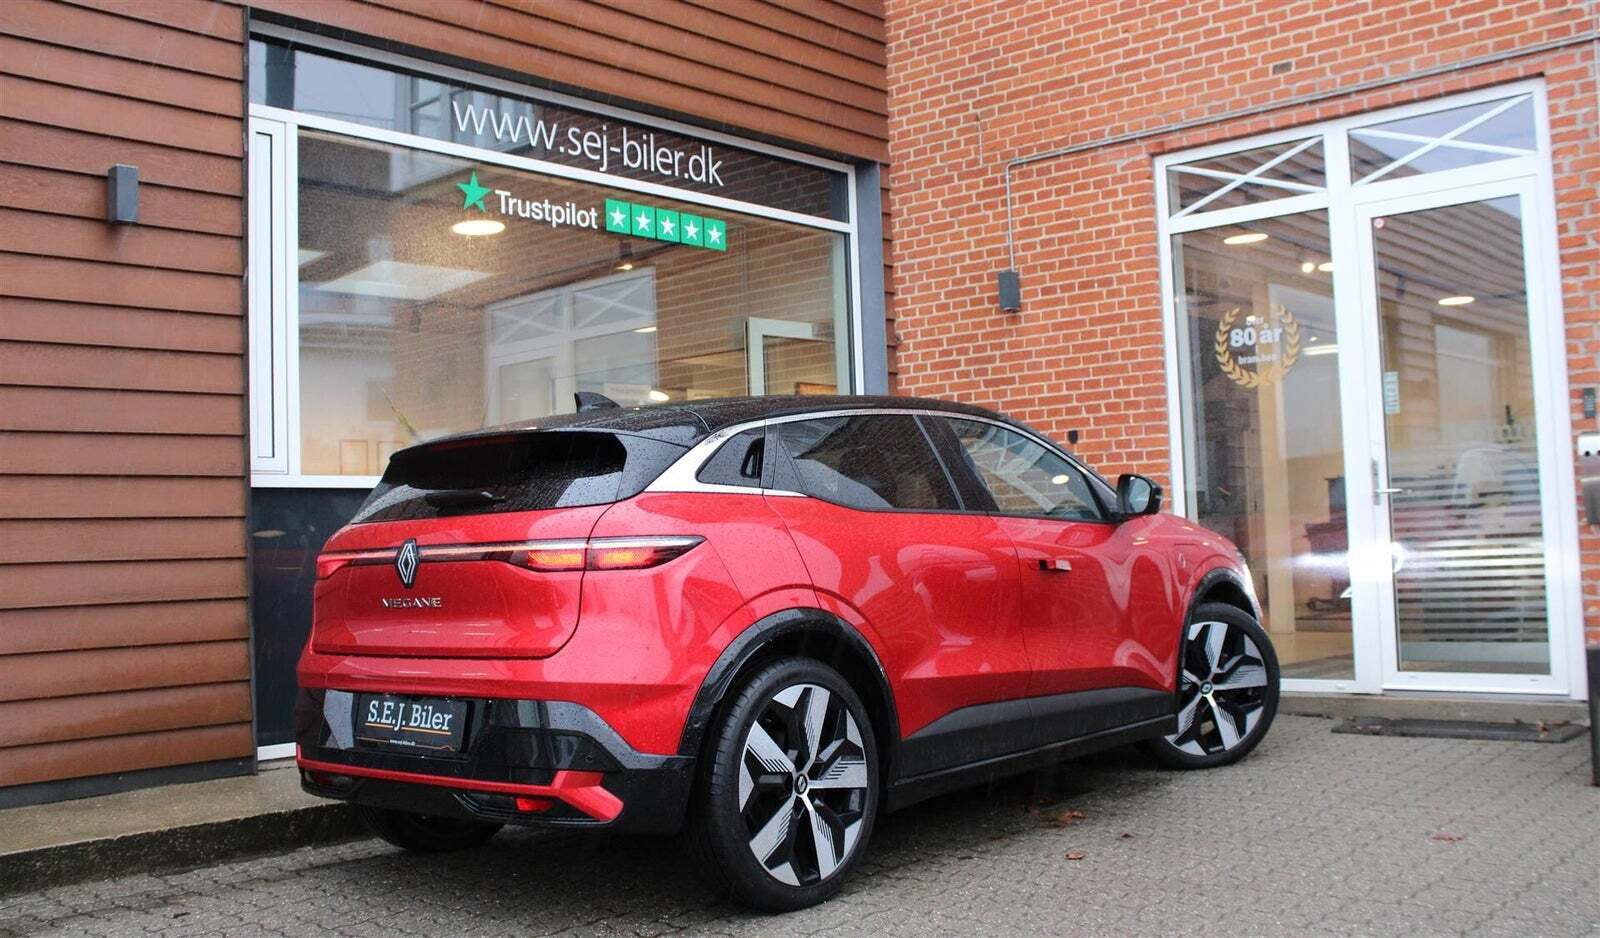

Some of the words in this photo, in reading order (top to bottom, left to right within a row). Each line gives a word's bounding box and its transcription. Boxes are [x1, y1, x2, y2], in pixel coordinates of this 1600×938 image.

[452, 101, 724, 186] www.sej-biler.dk
[495, 190, 598, 229] Trustpilot
[1230, 327, 1256, 347] 80
[382, 597, 442, 608] MEGANE
[367, 700, 406, 731] S.E.J.
[409, 704, 453, 730] Biler
